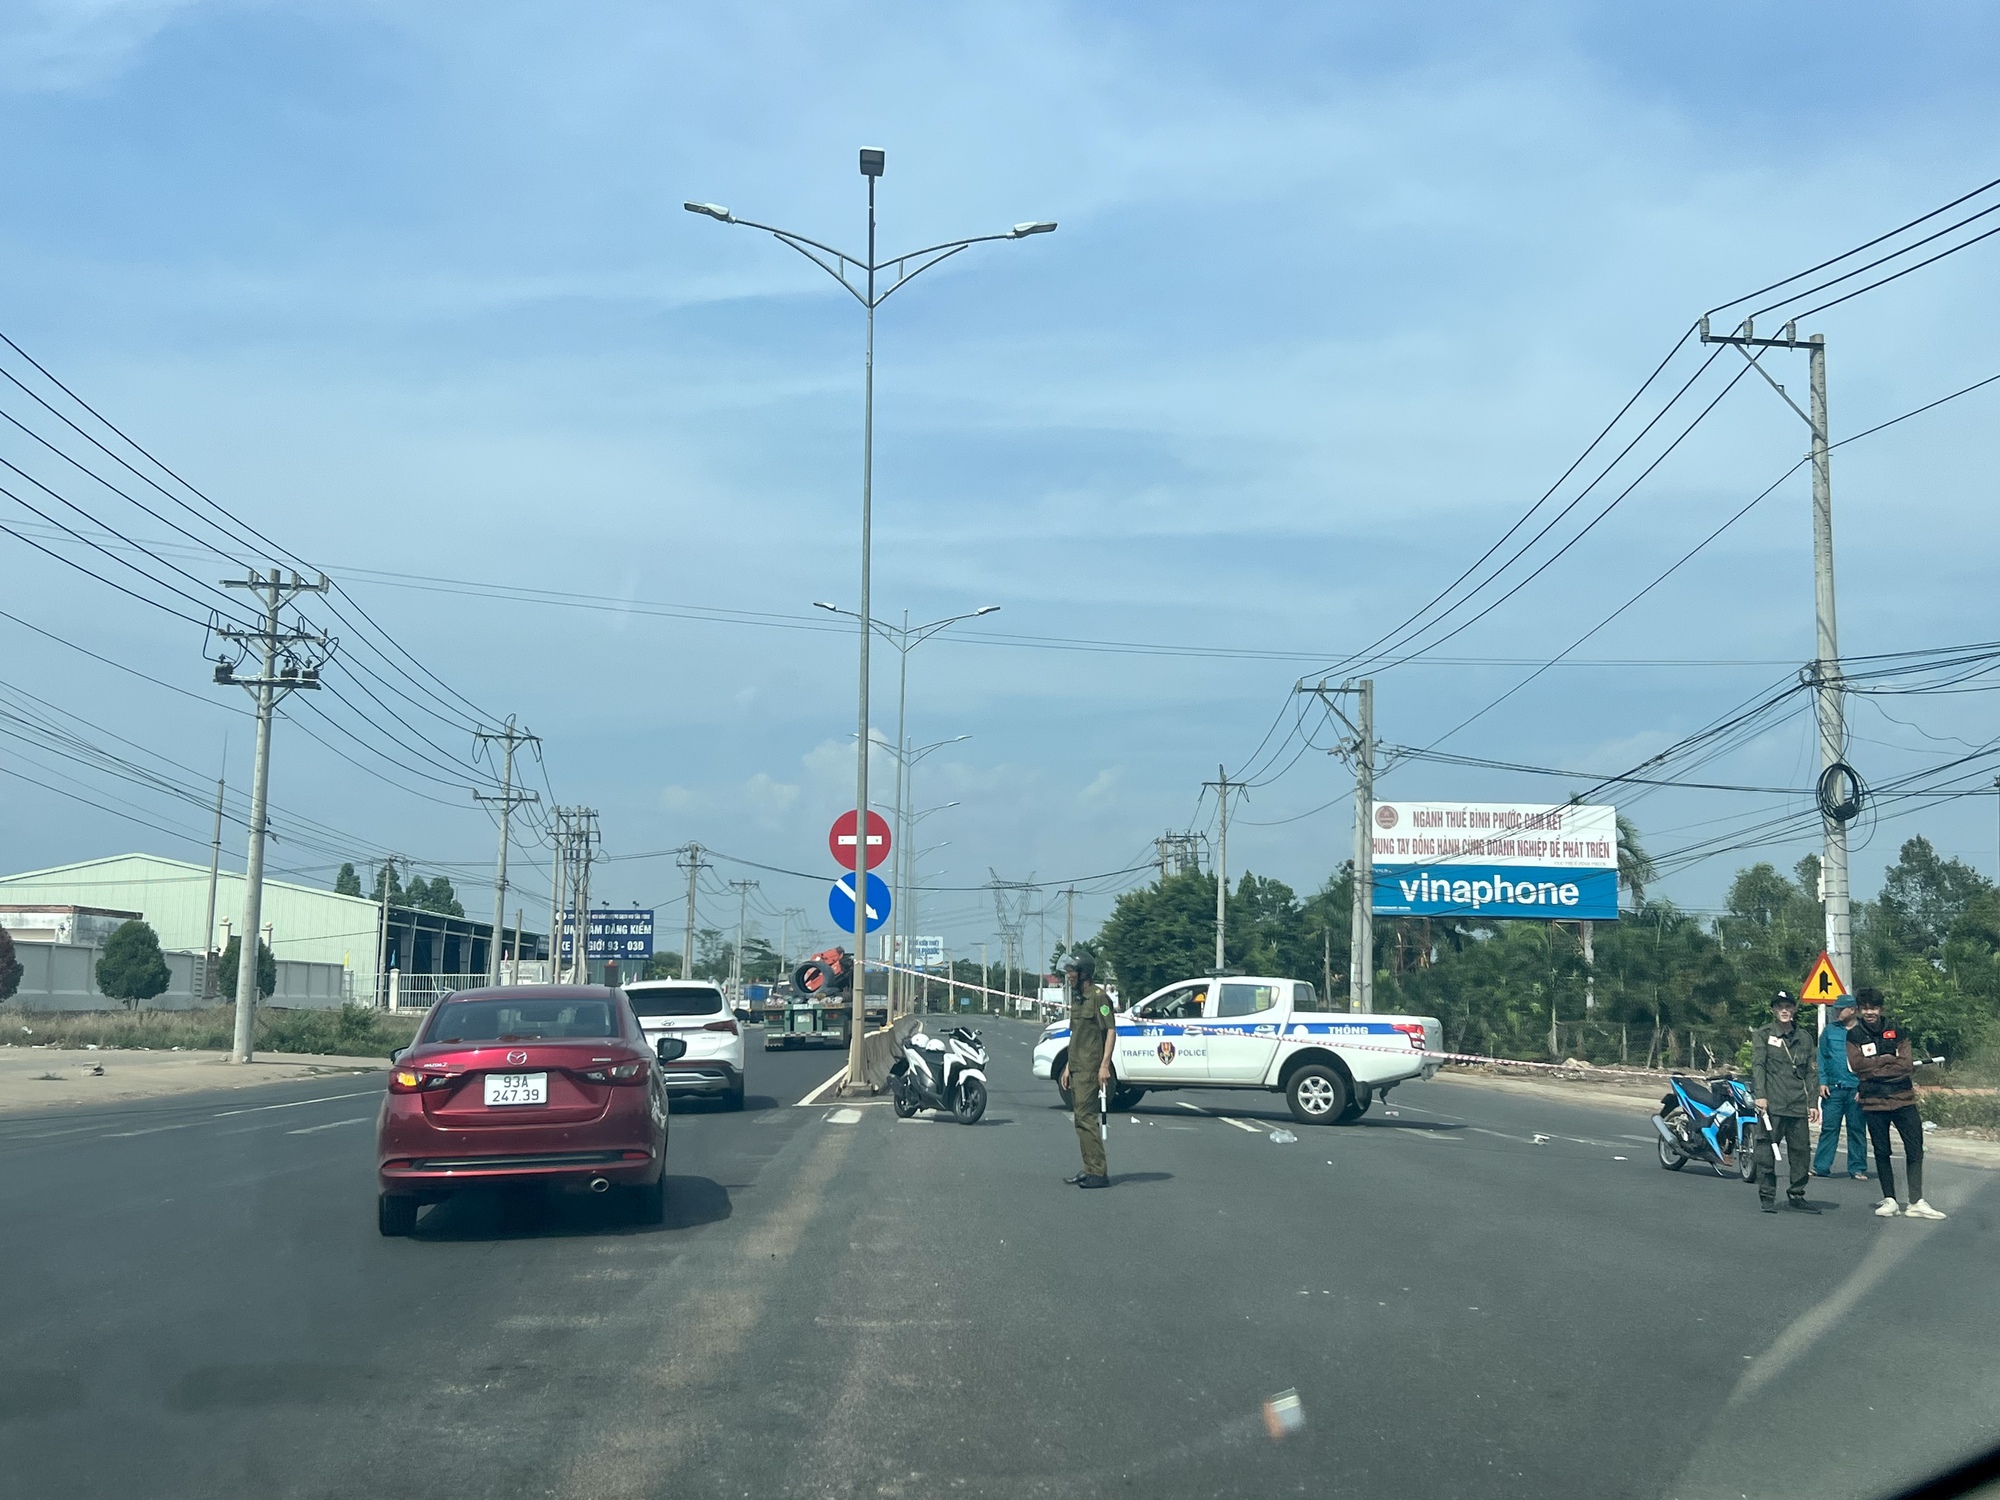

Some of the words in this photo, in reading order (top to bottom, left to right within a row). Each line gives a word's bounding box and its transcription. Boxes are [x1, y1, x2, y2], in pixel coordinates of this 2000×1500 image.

[1413, 807, 1443, 828] NGÀNH
[1446, 806, 1467, 828] THUẾ
[1470, 808, 1490, 828] BÌNH
[1493, 809, 1522, 830] PHƯỚC
[1524, 813, 1544, 830] CAM
[1372, 838, 1394, 854] HUNG
[1397, 838, 1410, 854] TAY
[1437, 835, 1460, 856] HÀNH
[1488, 838, 1515, 856] DOANH
[1517, 838, 1548, 860] NGHIỆP
[1550, 834, 1560, 858] ĐỂ
[1563, 838, 1584, 858] PHÁT
[1586, 835, 1610, 858] TRIỂN
[1400, 872, 1580, 909] vinaphone
[630, 920, 652, 934] KIỂM
[608, 941, 618, 950] 93
[1143, 1027, 1164, 1036] SÁT
[1328, 1024, 1368, 1034] THÔNG
[504, 1076, 529, 1088] 93A
[492, 1089, 539, 1102] 247.39
